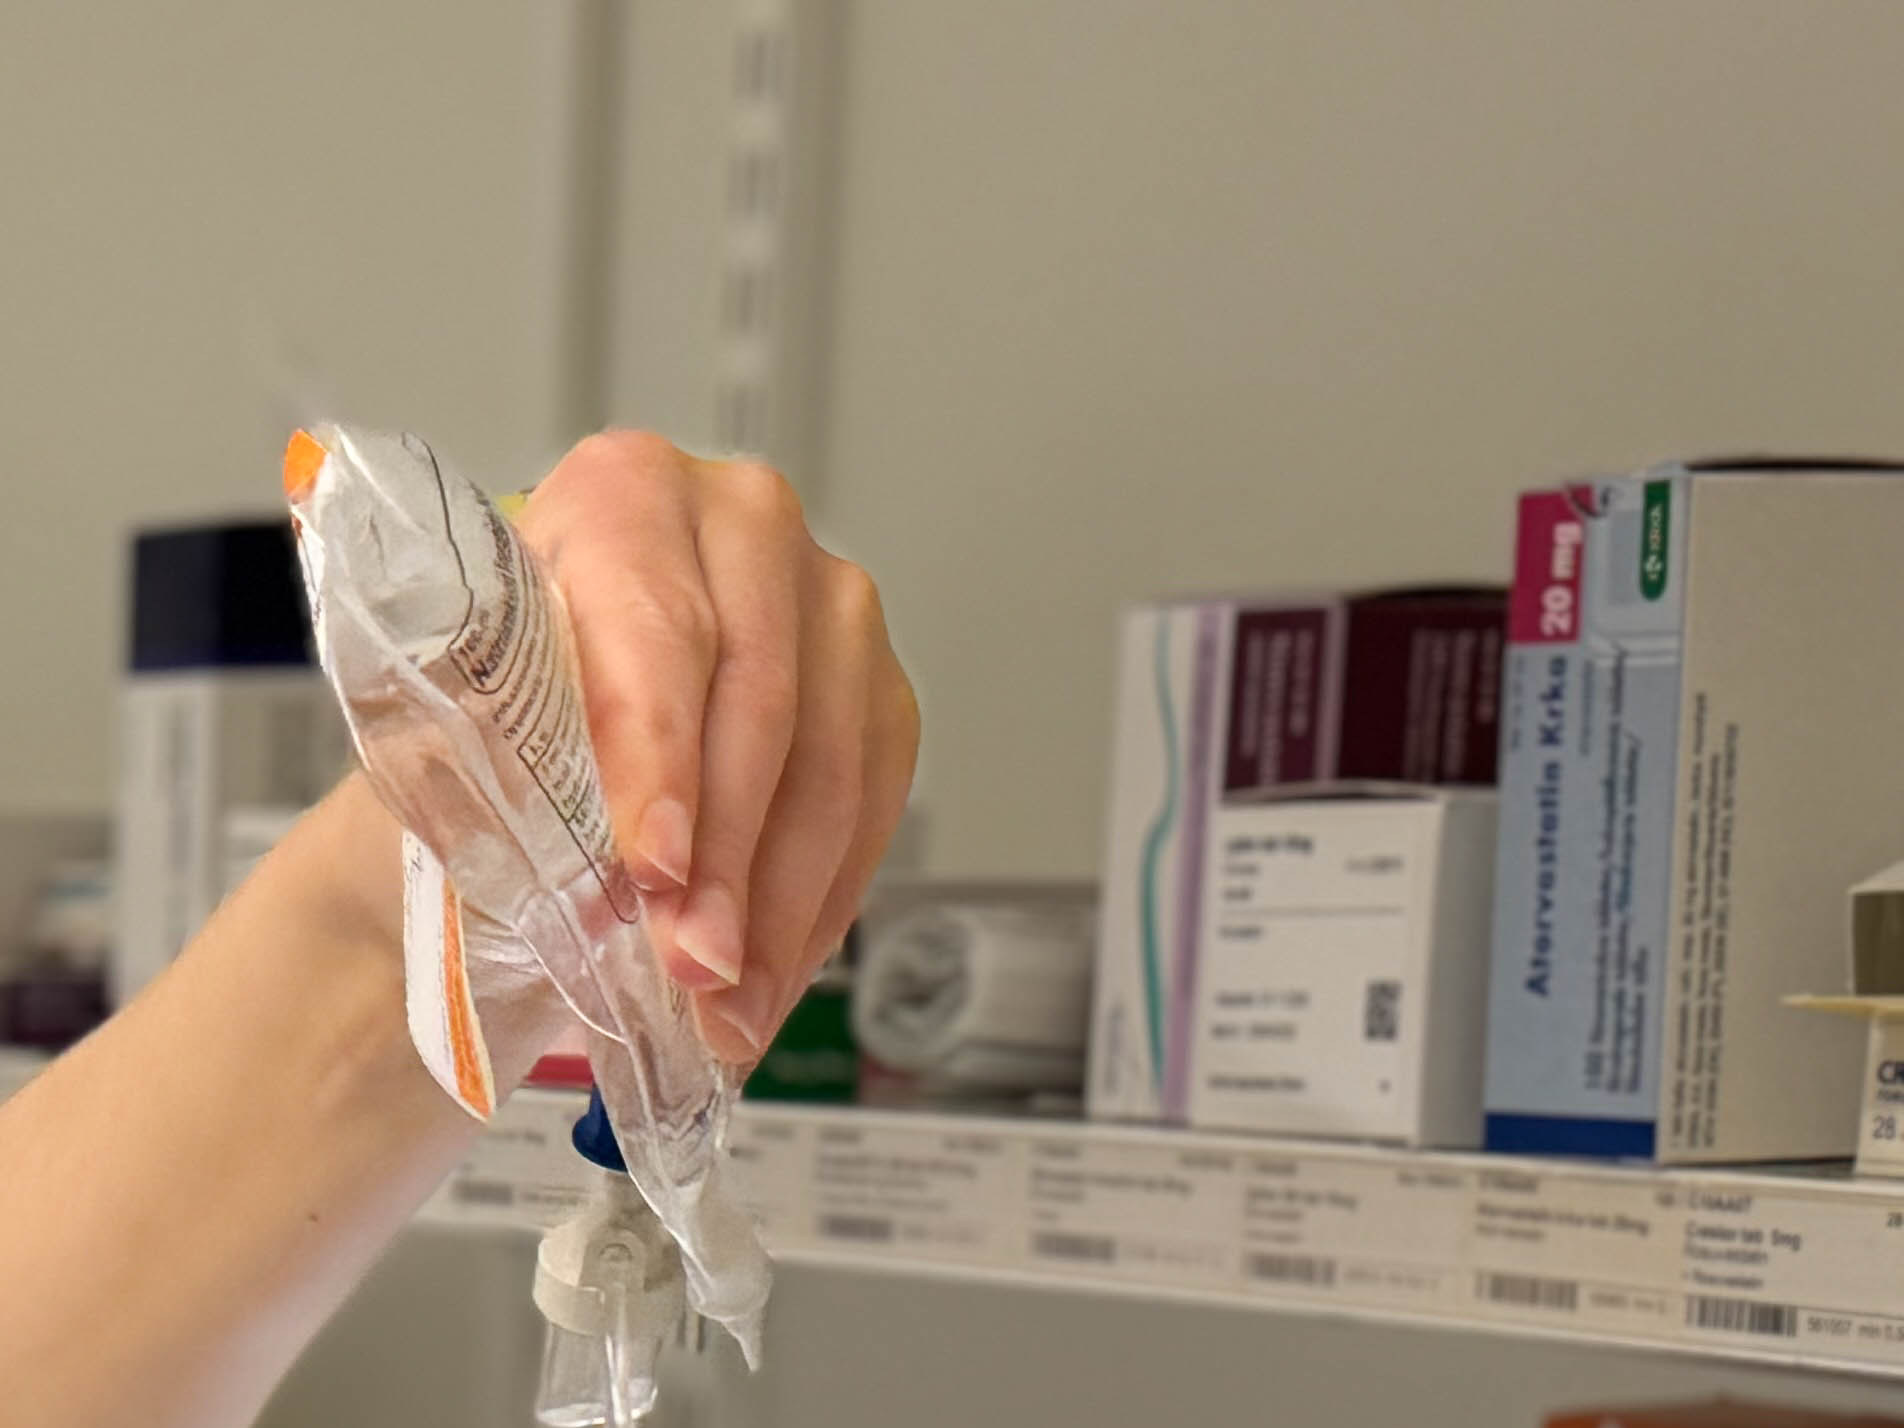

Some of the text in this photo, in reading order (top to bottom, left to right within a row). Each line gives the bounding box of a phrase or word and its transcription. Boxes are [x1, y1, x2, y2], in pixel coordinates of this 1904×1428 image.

[1525, 520, 1583, 998] Atorvastatin Krka 20 mg
